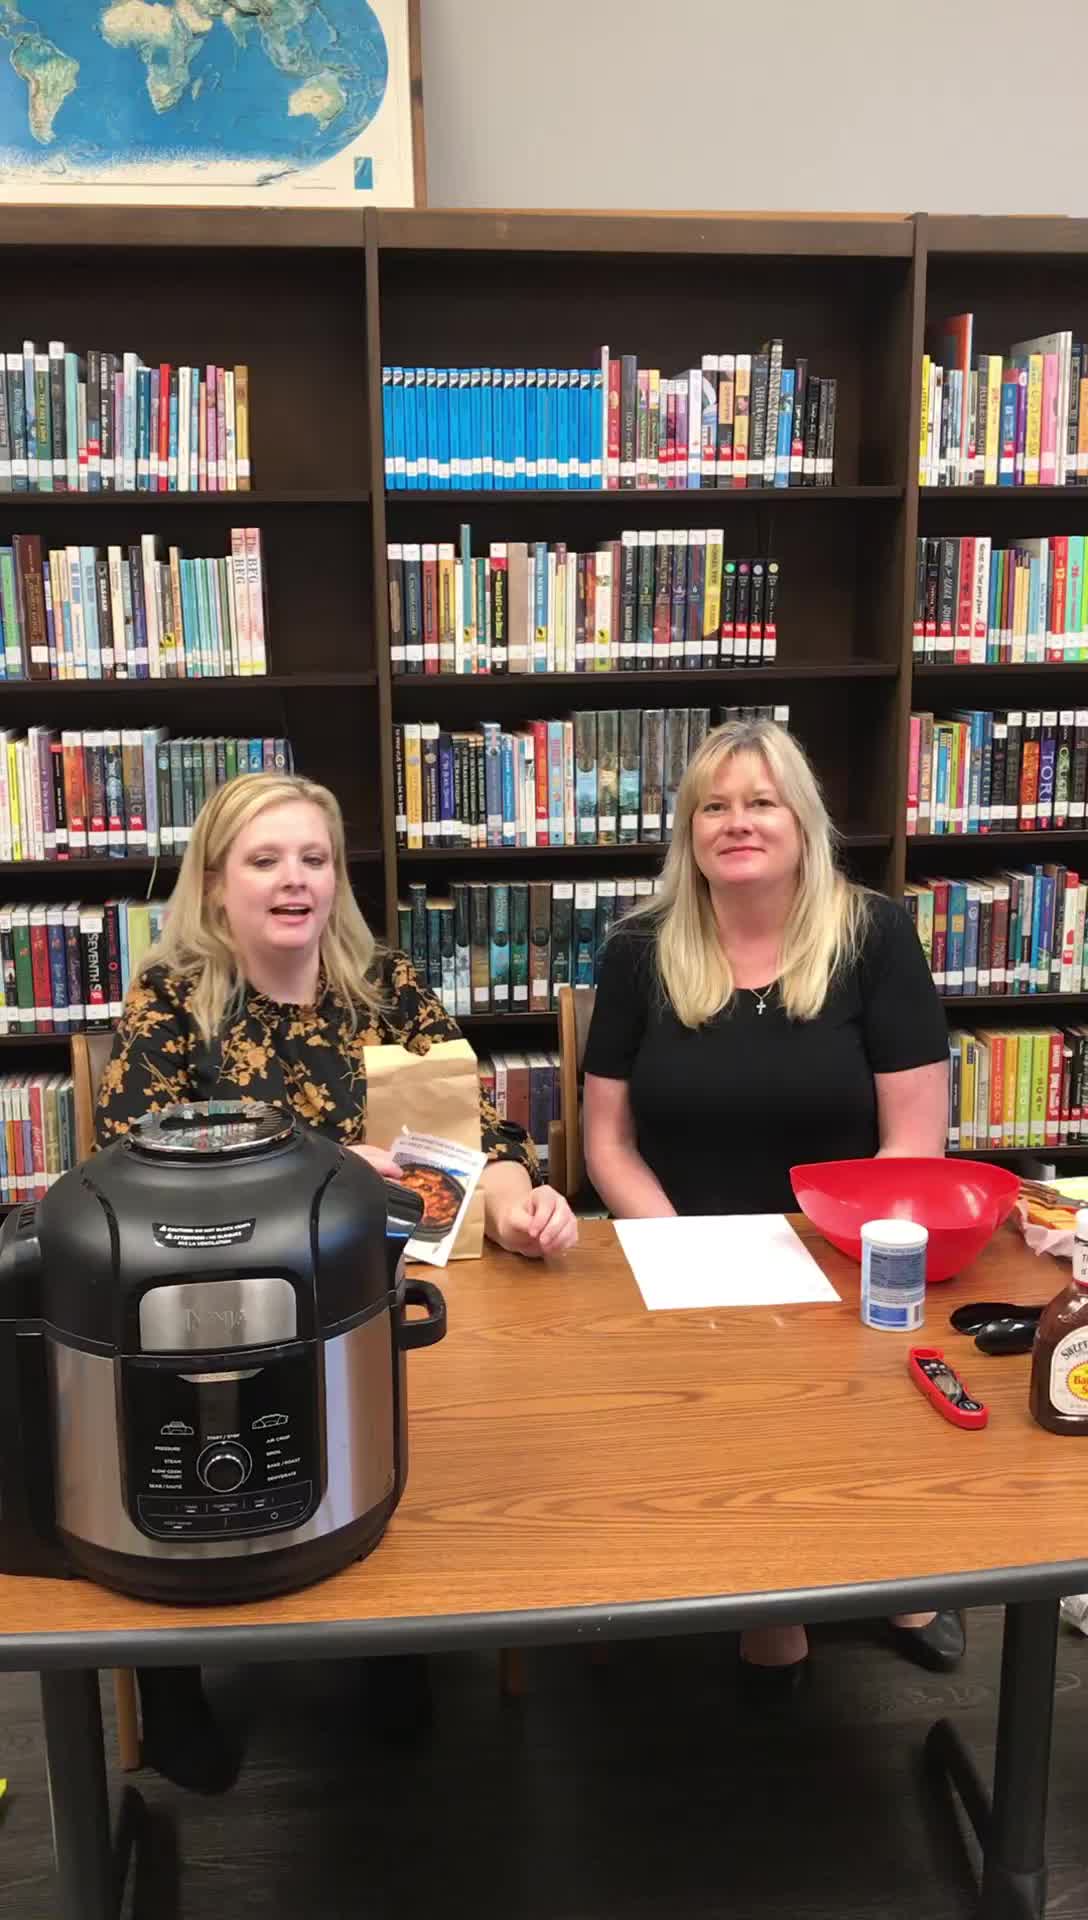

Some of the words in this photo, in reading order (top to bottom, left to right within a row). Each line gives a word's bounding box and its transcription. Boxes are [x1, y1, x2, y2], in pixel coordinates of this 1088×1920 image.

[235, 560, 245, 585] BFG
[248, 558, 259, 583] BFG
[88, 934, 101, 982] SEVENTH
